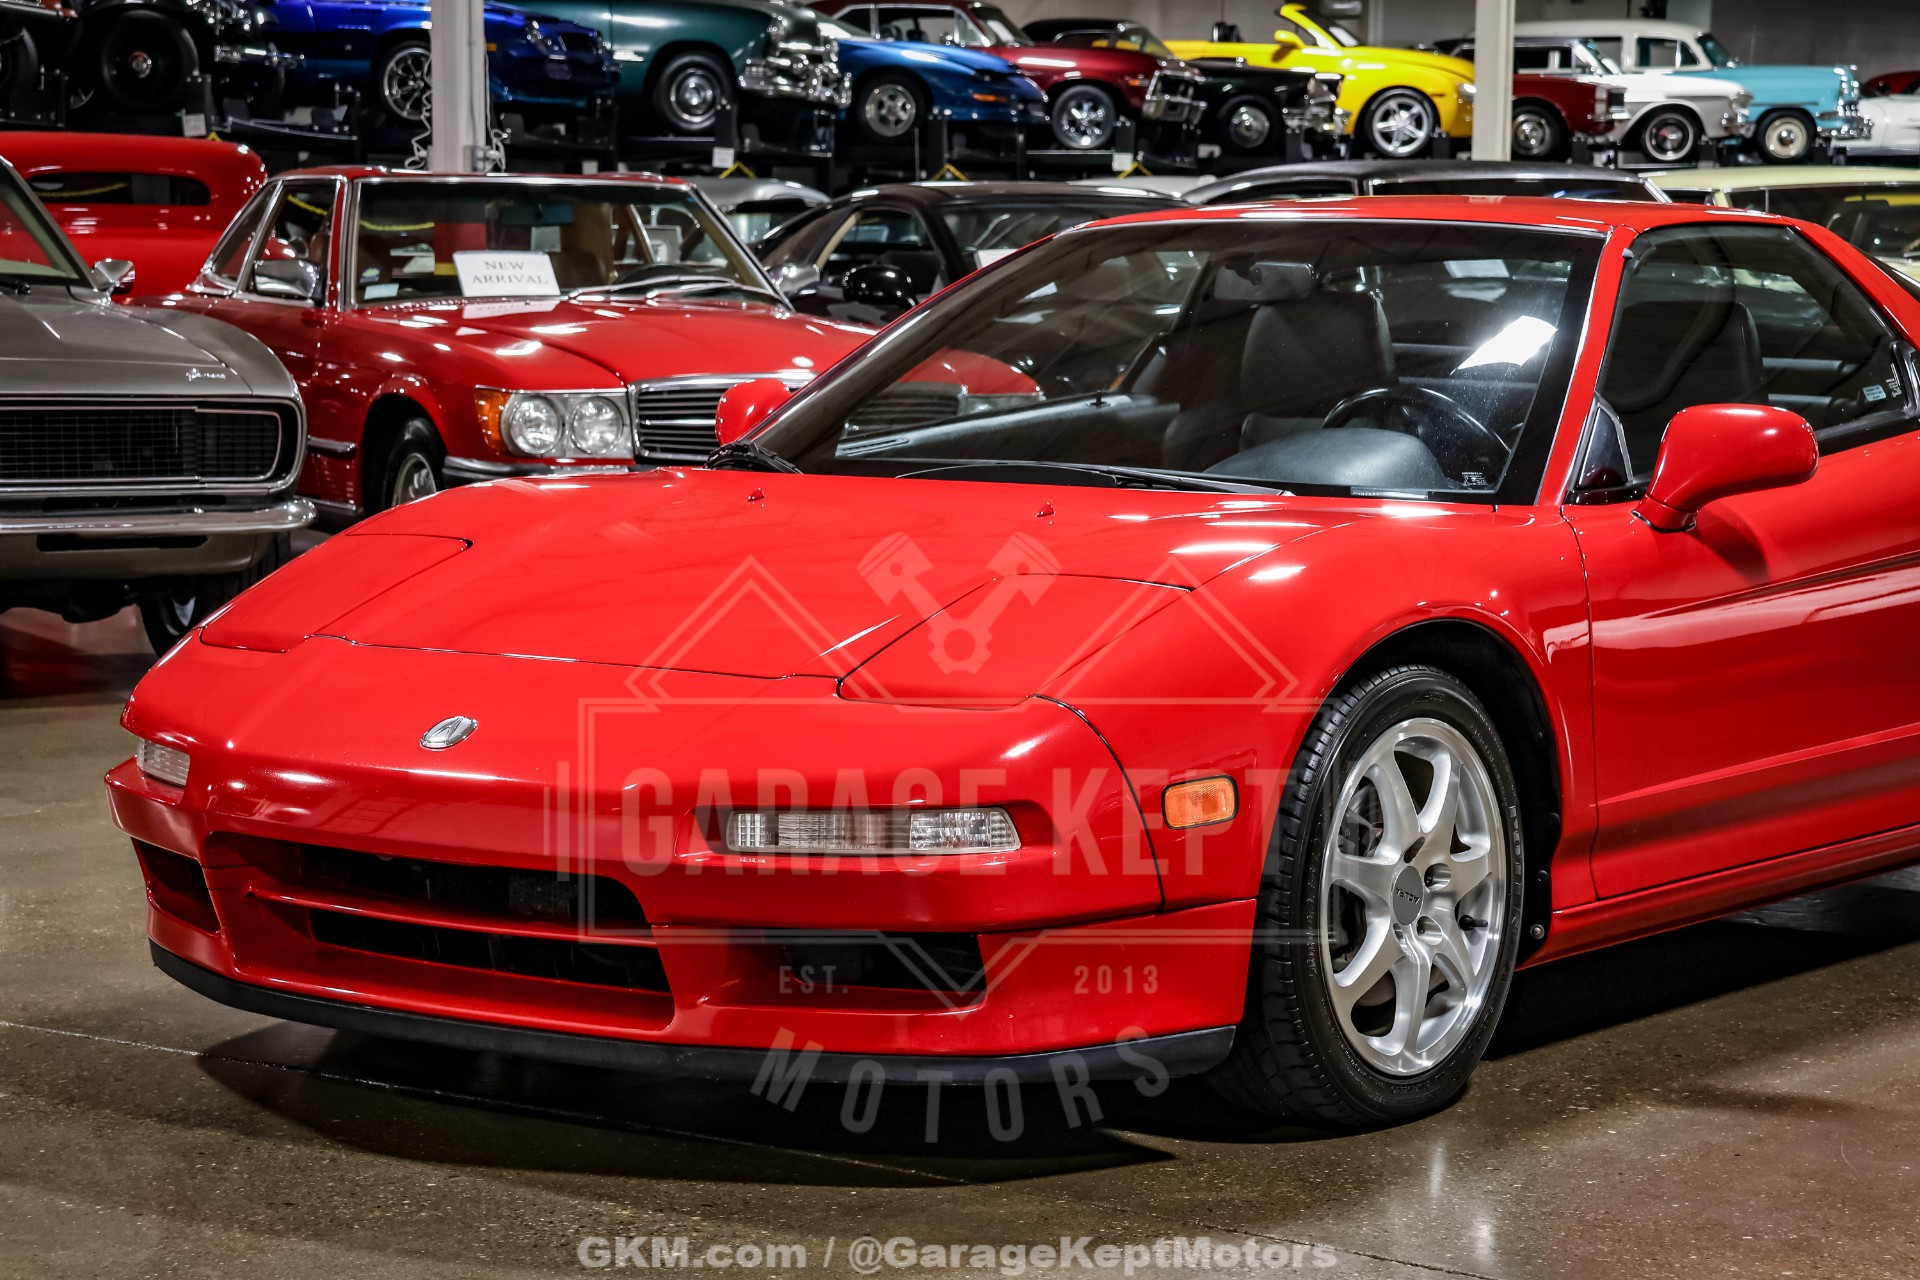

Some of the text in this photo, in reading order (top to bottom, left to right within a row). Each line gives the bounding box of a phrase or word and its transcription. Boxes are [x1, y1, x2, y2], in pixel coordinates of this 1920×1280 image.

[483, 261, 525, 271] NEW
[472, 274, 549, 286] ARRIVAL
[1396, 888, 1420, 905] ACURA
